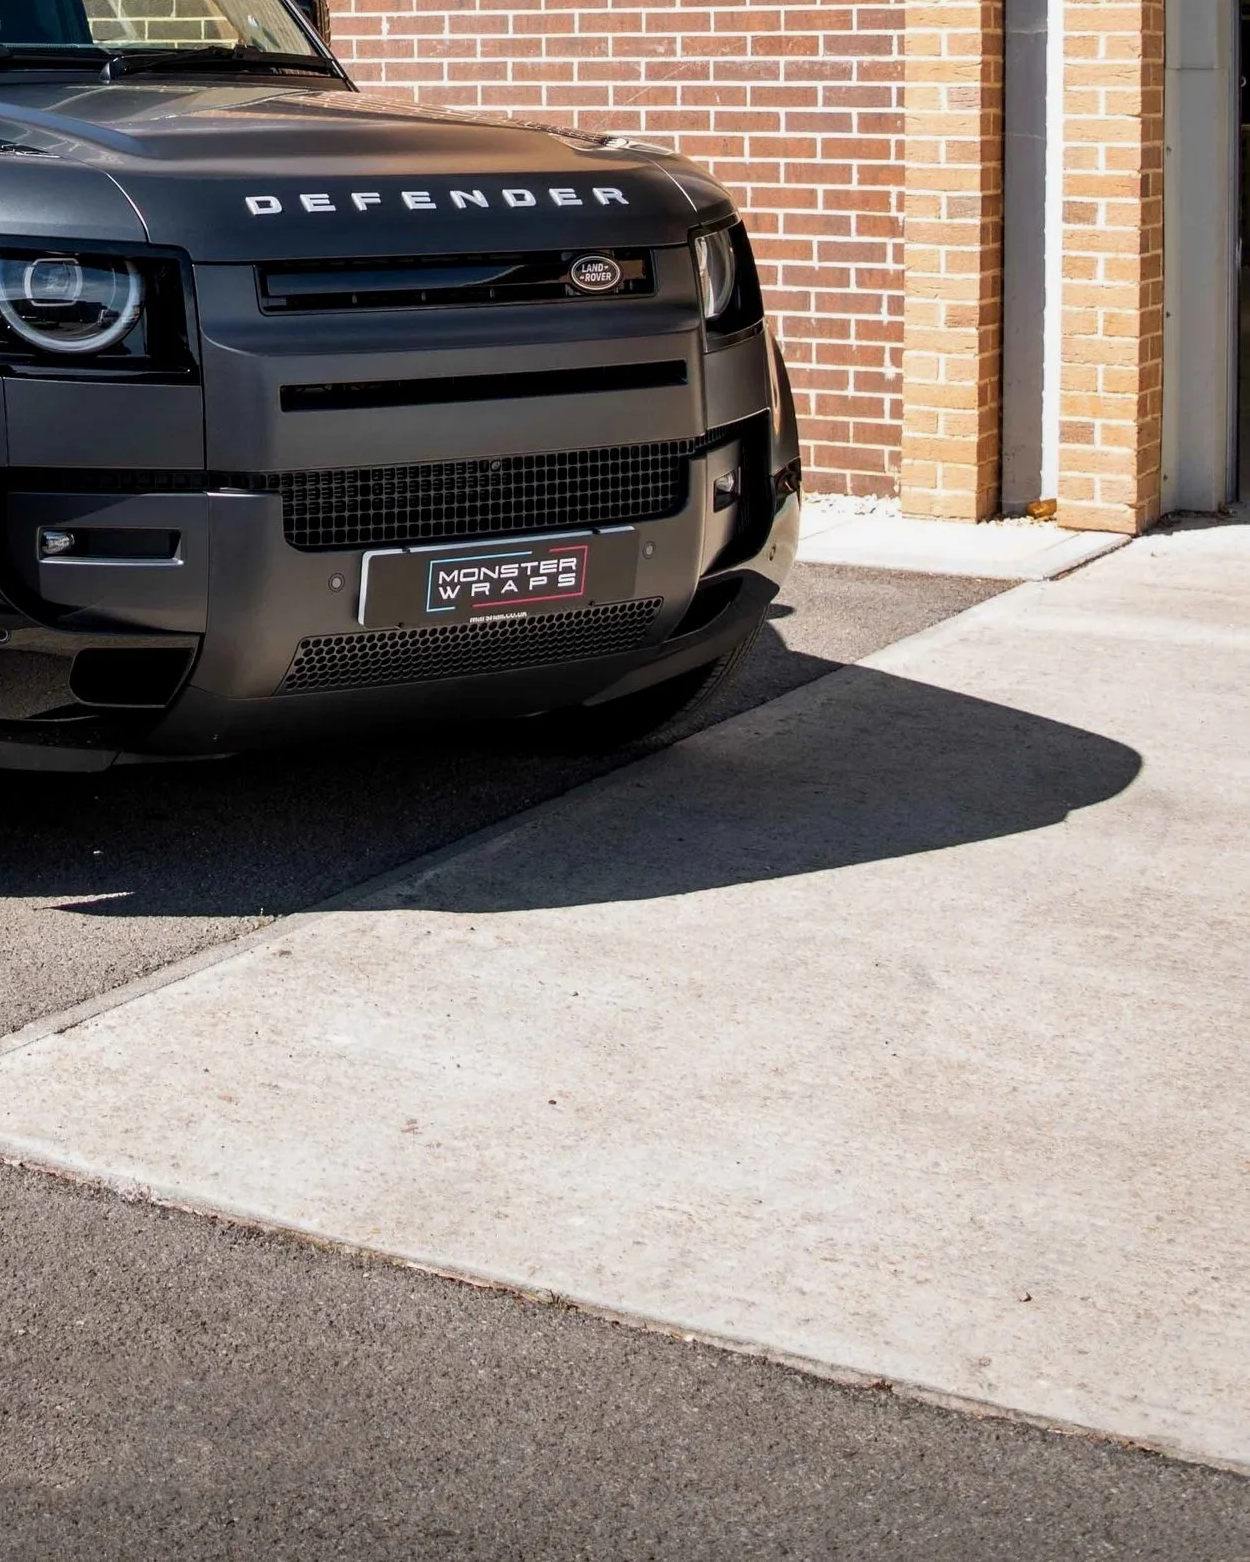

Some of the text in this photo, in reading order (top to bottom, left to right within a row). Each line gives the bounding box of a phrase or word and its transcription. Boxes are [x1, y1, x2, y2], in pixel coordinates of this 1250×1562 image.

[245, 187, 629, 215] DEFENDER
[438, 557, 577, 584] MONSTER
[438, 573, 576, 600] WRAPS
